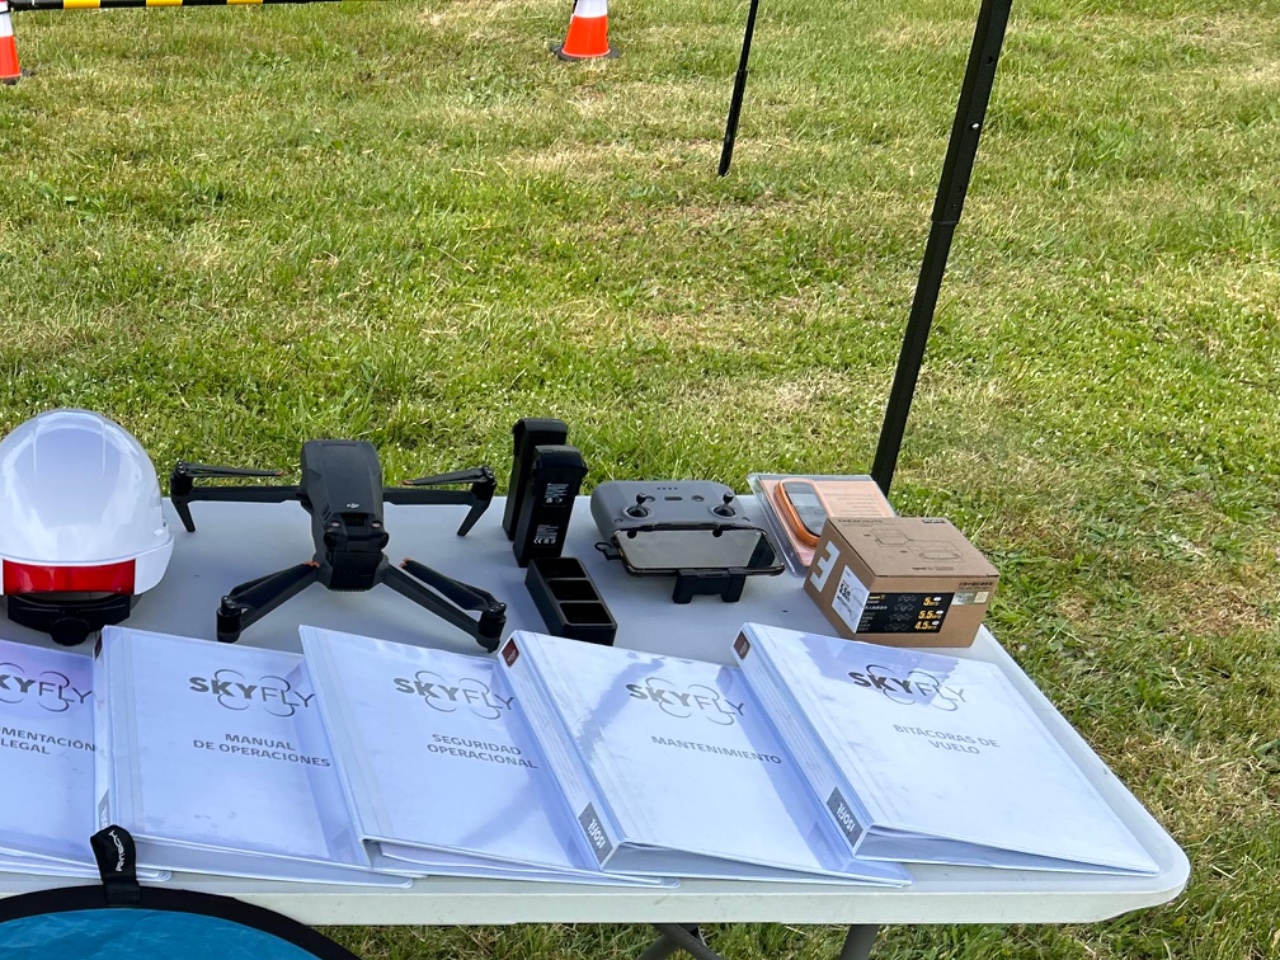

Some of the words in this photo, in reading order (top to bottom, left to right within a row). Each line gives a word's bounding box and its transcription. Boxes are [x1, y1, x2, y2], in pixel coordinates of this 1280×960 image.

[189, 676, 315, 708] SKYFLY
[393, 677, 515, 711] SKYFLY
[625, 683, 744, 716] SKYFLY
[848, 671, 966, 703] SKYFLY
[0, 738, 50, 755] LEGAL
[193, 739, 215, 751] DE
[219, 743, 331, 767] OPERACIONES
[225, 733, 297, 751] MANUAL
[432, 733, 522, 755] SEGURIDAD
[651, 735, 782, 764] MANTENIMIENTO
[928, 739, 980, 755] VUELO
[978, 737, 1000, 748] DE
[427, 744, 539, 769] OPERACIONAL
